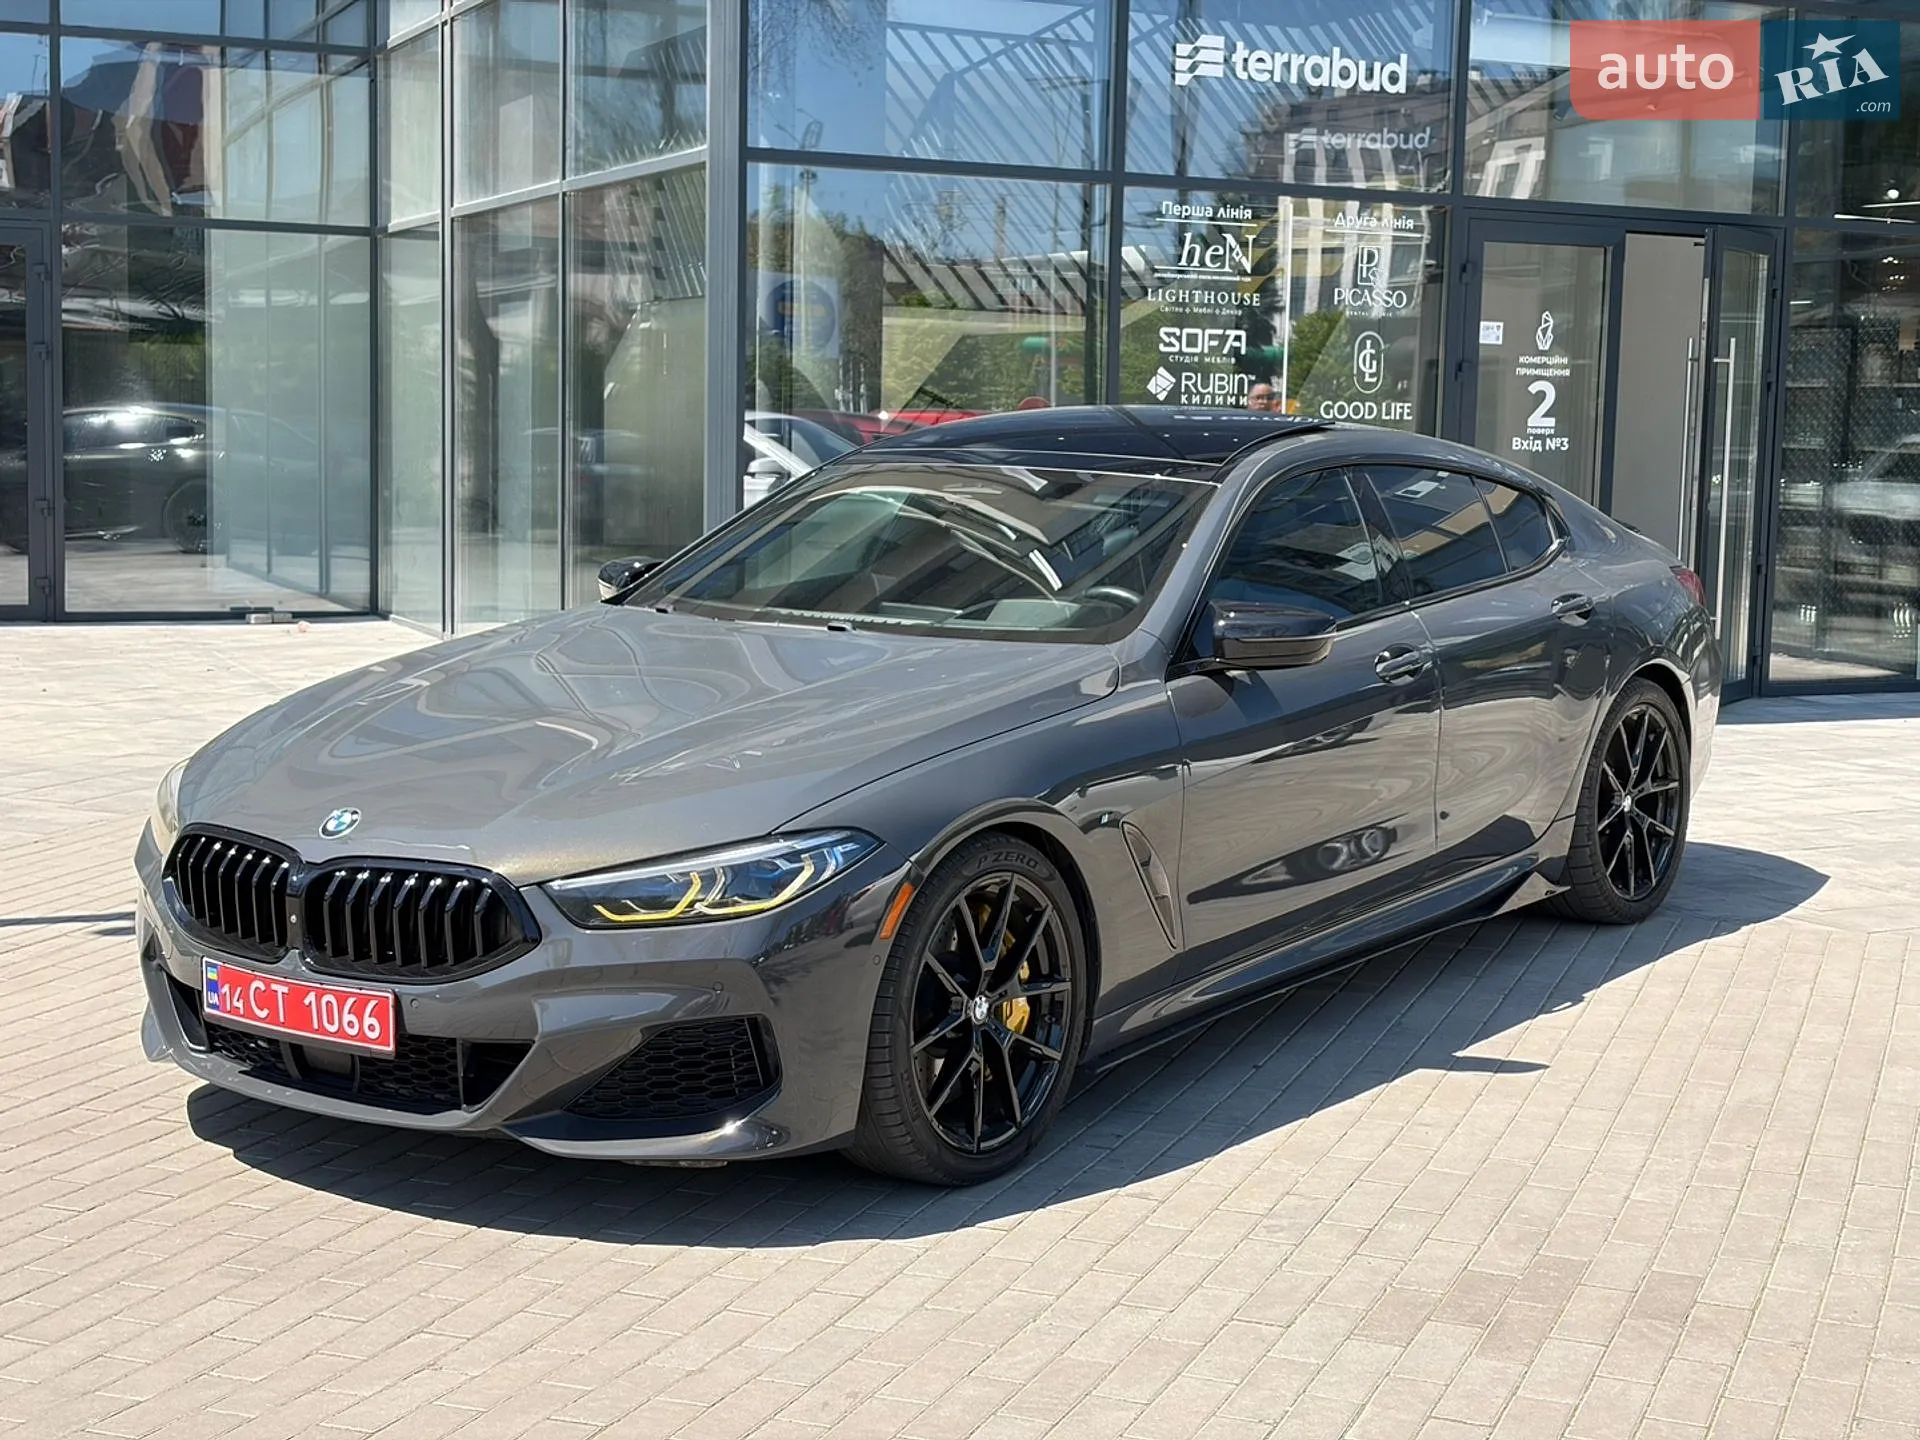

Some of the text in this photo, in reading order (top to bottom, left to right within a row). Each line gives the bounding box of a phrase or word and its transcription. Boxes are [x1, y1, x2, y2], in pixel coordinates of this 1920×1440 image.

[1232, 41, 1408, 94] terrabud
[1322, 126, 1431, 150] terrabud
[1162, 201, 1252, 219] Перша лінія
[1334, 212, 1377, 229] Друга
[1147, 288, 1261, 307] LIGHTHOUSE
[1334, 288, 1407, 308] PICASSO
[1158, 326, 1247, 355] SOFA
[1518, 355, 1568, 365] КОМЕРЦІЙНІ
[1515, 367, 1570, 377] ПРИМІЩЕННЯ
[1181, 394, 1248, 406] КИЛИМИ
[1527, 379, 1556, 427] 2
[1320, 400, 1413, 420] GOOD LIFE
[1526, 427, 1555, 435] поверх
[1512, 436, 1569, 452] Вхід №3
[992, 851, 1039, 869] ZERO
[221, 983, 245, 1015] 14
[303, 991, 382, 1040] 1066
